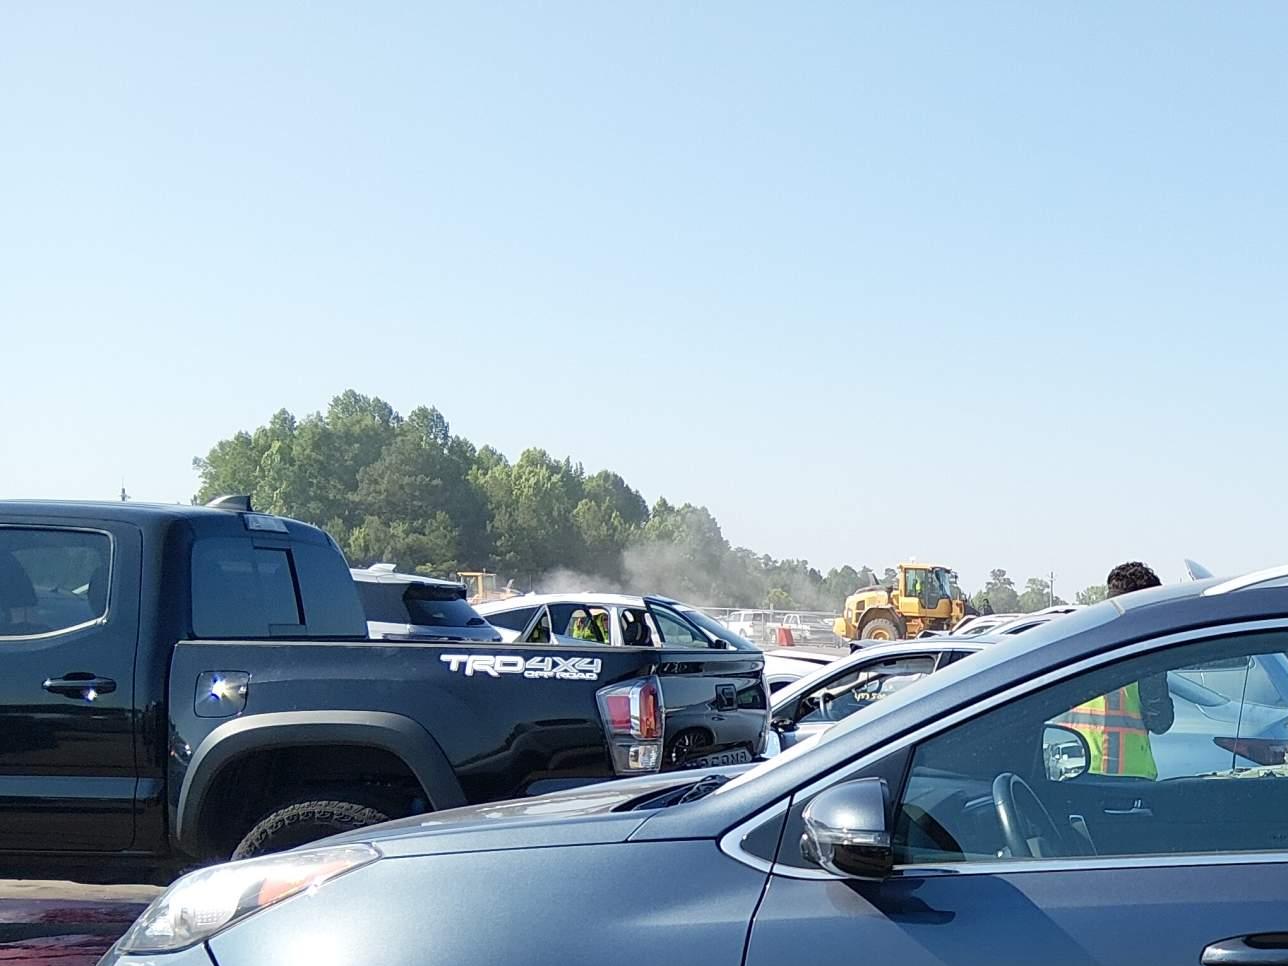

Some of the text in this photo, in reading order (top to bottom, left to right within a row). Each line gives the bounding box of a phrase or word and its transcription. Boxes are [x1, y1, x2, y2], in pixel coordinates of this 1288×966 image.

[439, 654, 526, 678] TRD
[523, 670, 599, 681] OFF ROAD
